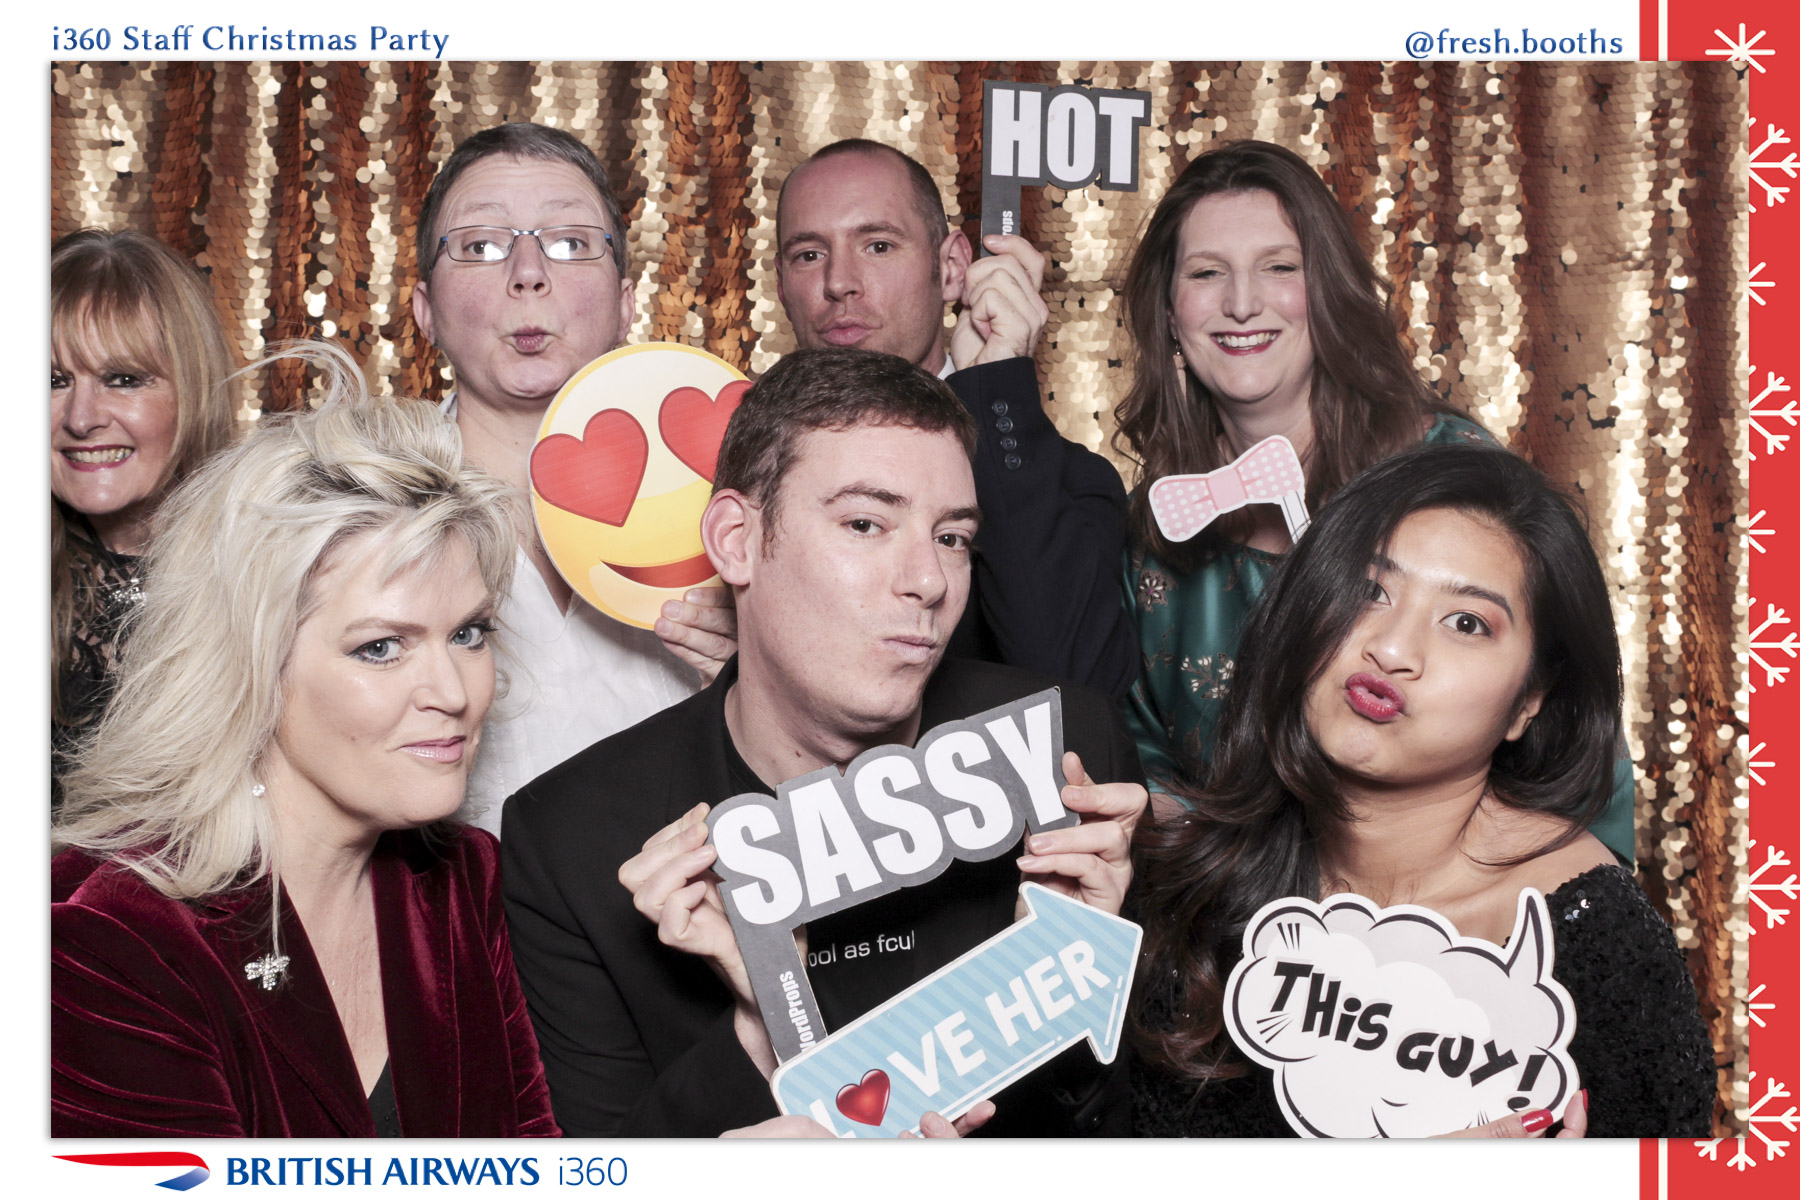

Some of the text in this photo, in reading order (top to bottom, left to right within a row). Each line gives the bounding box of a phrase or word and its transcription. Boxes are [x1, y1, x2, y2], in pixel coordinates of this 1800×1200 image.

[990, 88, 1145, 184] HOT
[712, 701, 1067, 925] SASSY
[808, 930, 915, 967] ool as fcu
[984, 940, 1111, 1047] HER
[1396, 1032, 1548, 1111] GUY!
